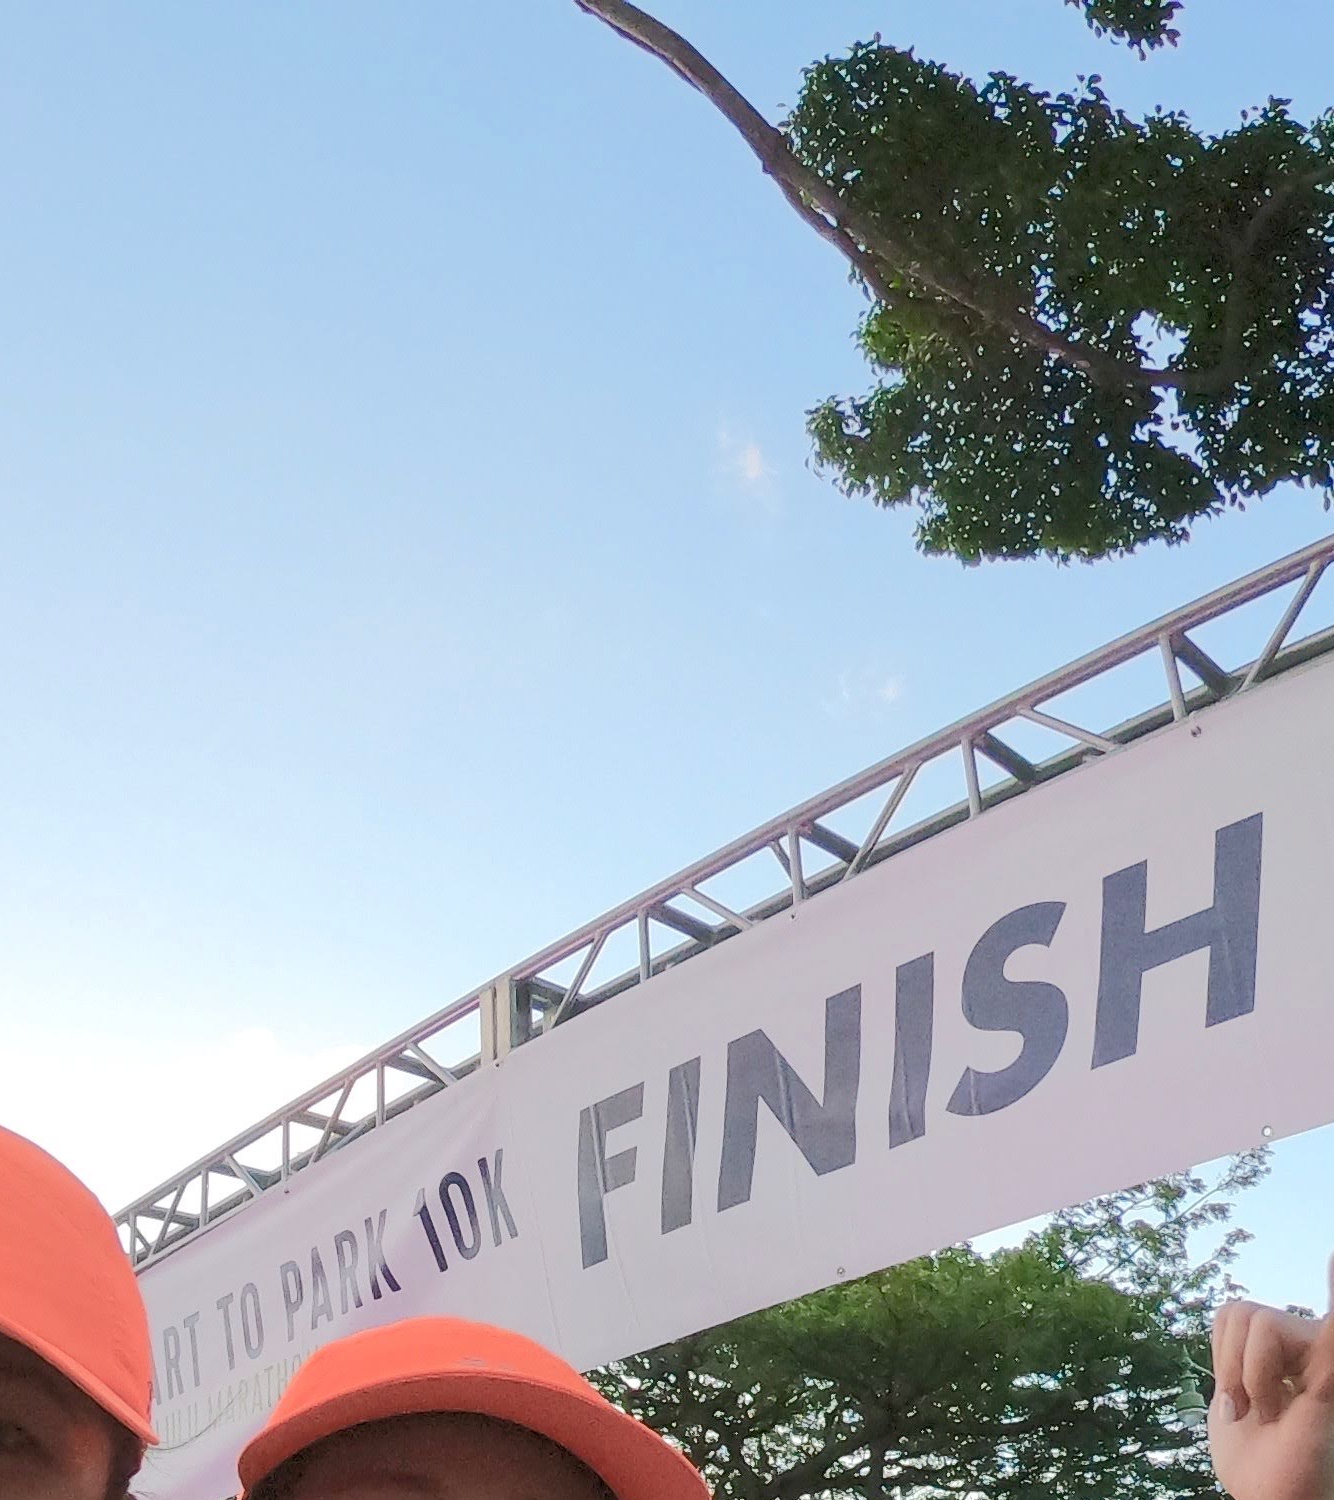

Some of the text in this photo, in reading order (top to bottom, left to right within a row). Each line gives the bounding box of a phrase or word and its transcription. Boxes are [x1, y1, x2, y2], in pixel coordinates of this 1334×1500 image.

[577, 811, 1264, 1270] FINISH
[216, 1282, 265, 1371] TO
[280, 1209, 402, 1343] PARK
[412, 1148, 519, 1273] 10K
